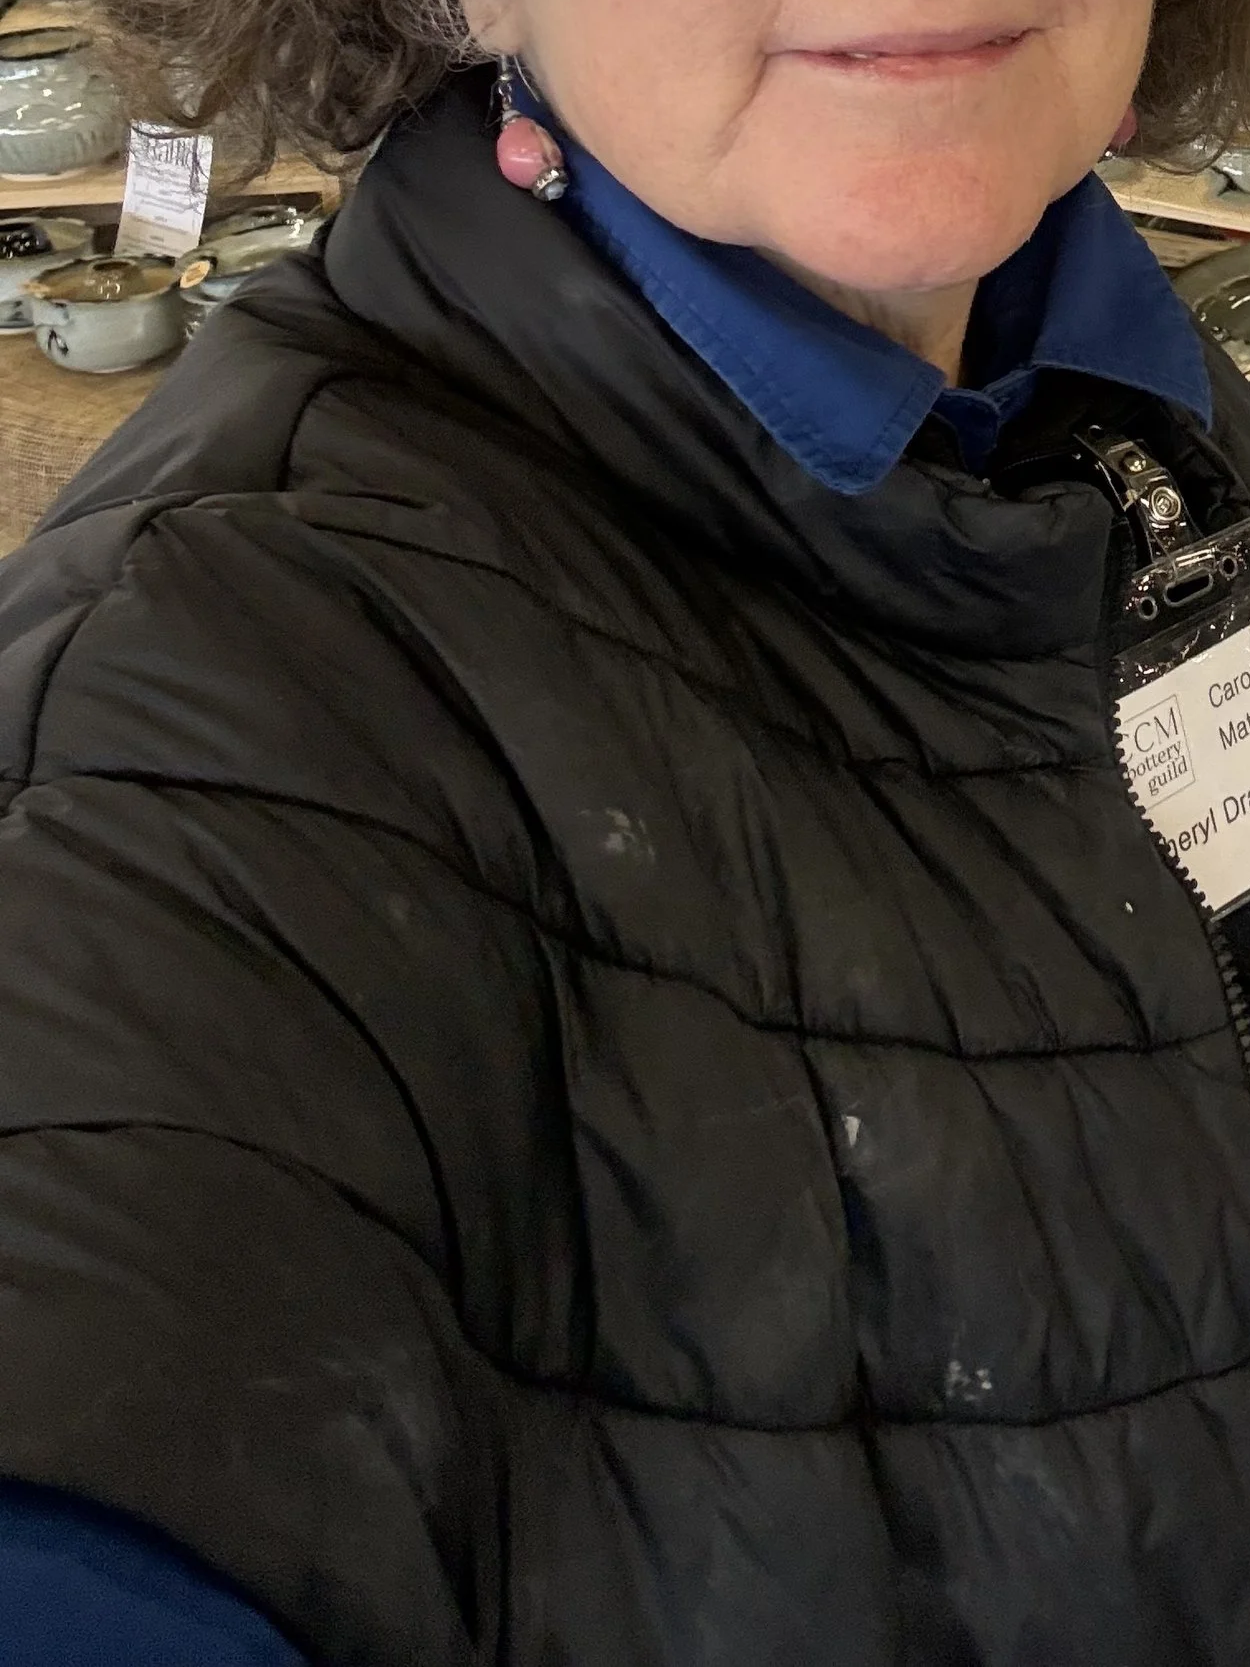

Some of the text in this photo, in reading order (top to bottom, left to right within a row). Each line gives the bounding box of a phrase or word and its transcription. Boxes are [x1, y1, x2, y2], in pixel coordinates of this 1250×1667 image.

[1123, 707, 1179, 762] CM
[1148, 755, 1188, 796] guild
[1161, 807, 1218, 859] heryl
